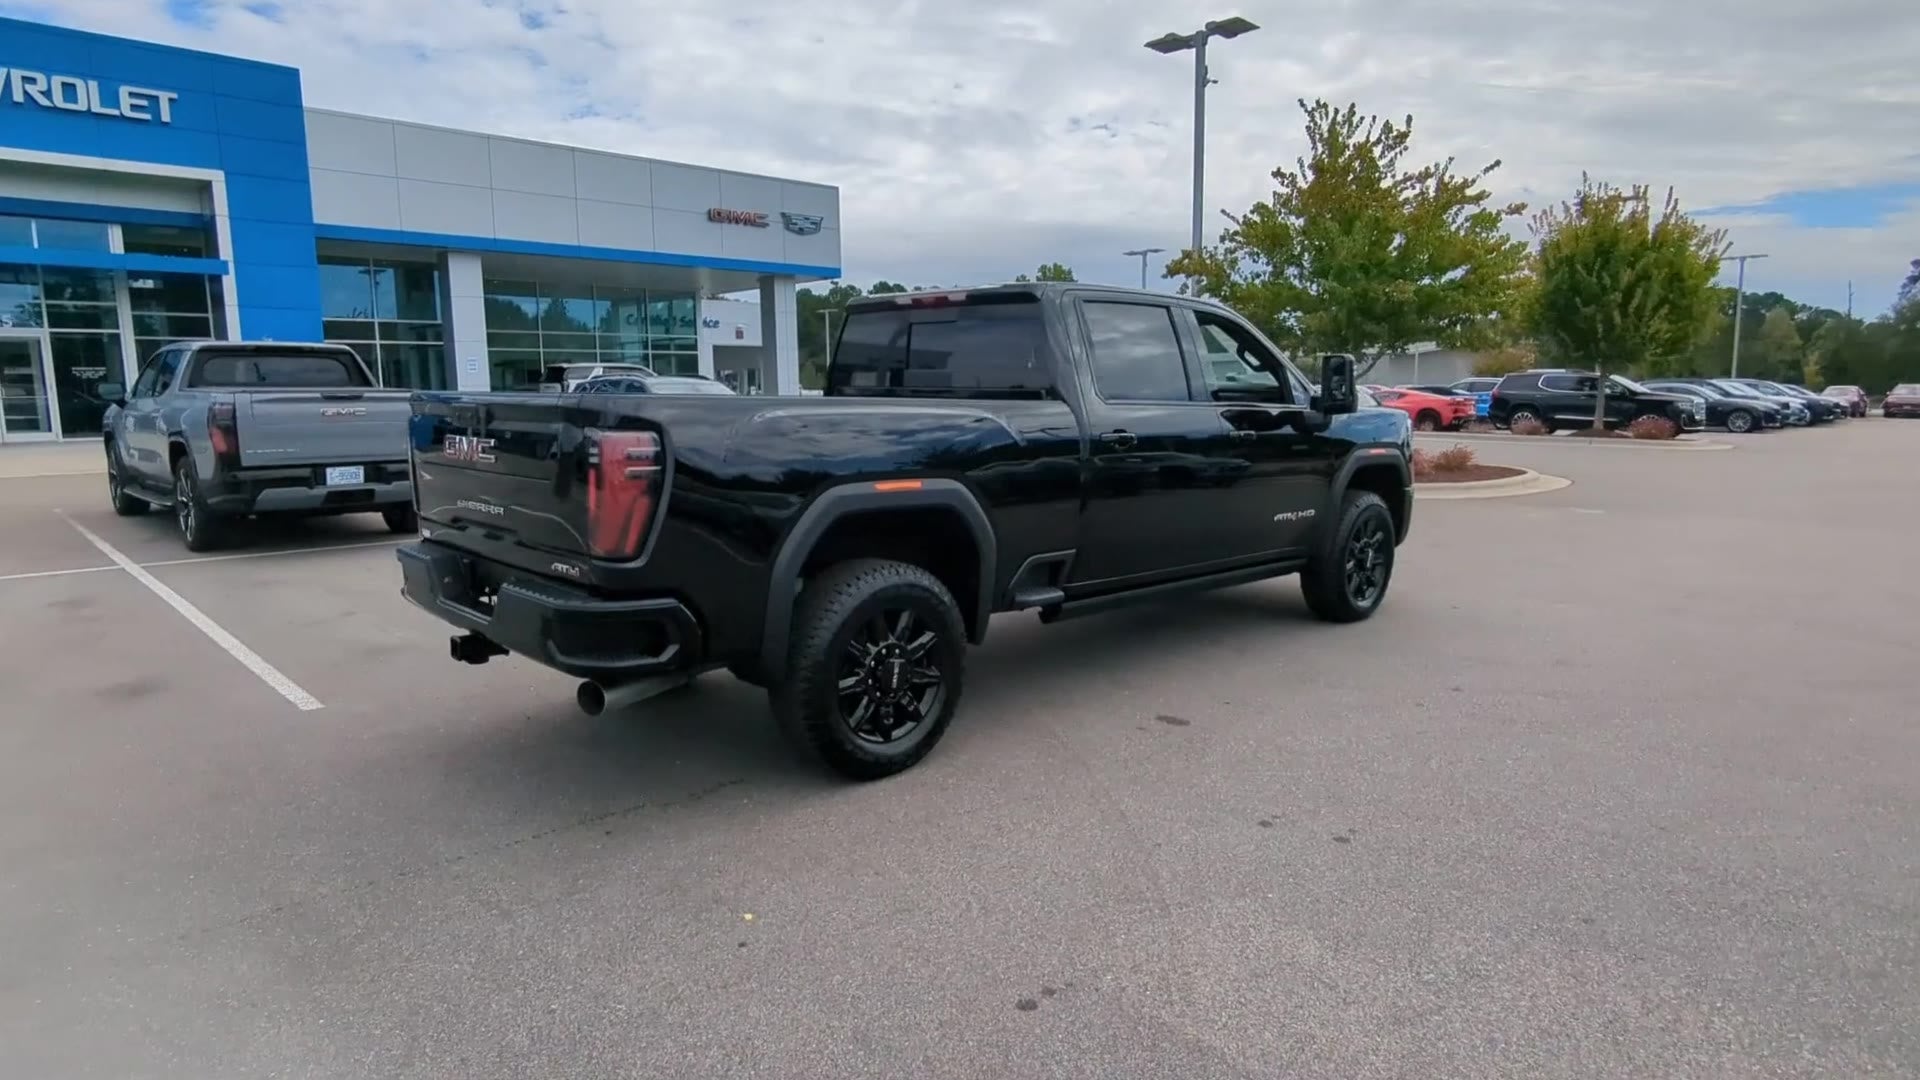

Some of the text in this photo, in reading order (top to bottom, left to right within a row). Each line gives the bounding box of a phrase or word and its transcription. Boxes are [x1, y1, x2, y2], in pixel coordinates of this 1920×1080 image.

[0, 67, 178, 123] ROLET
[708, 208, 770, 228] GMC
[320, 407, 367, 416] GMC
[443, 434, 496, 463] GMC
[457, 500, 504, 515] SIERRA
